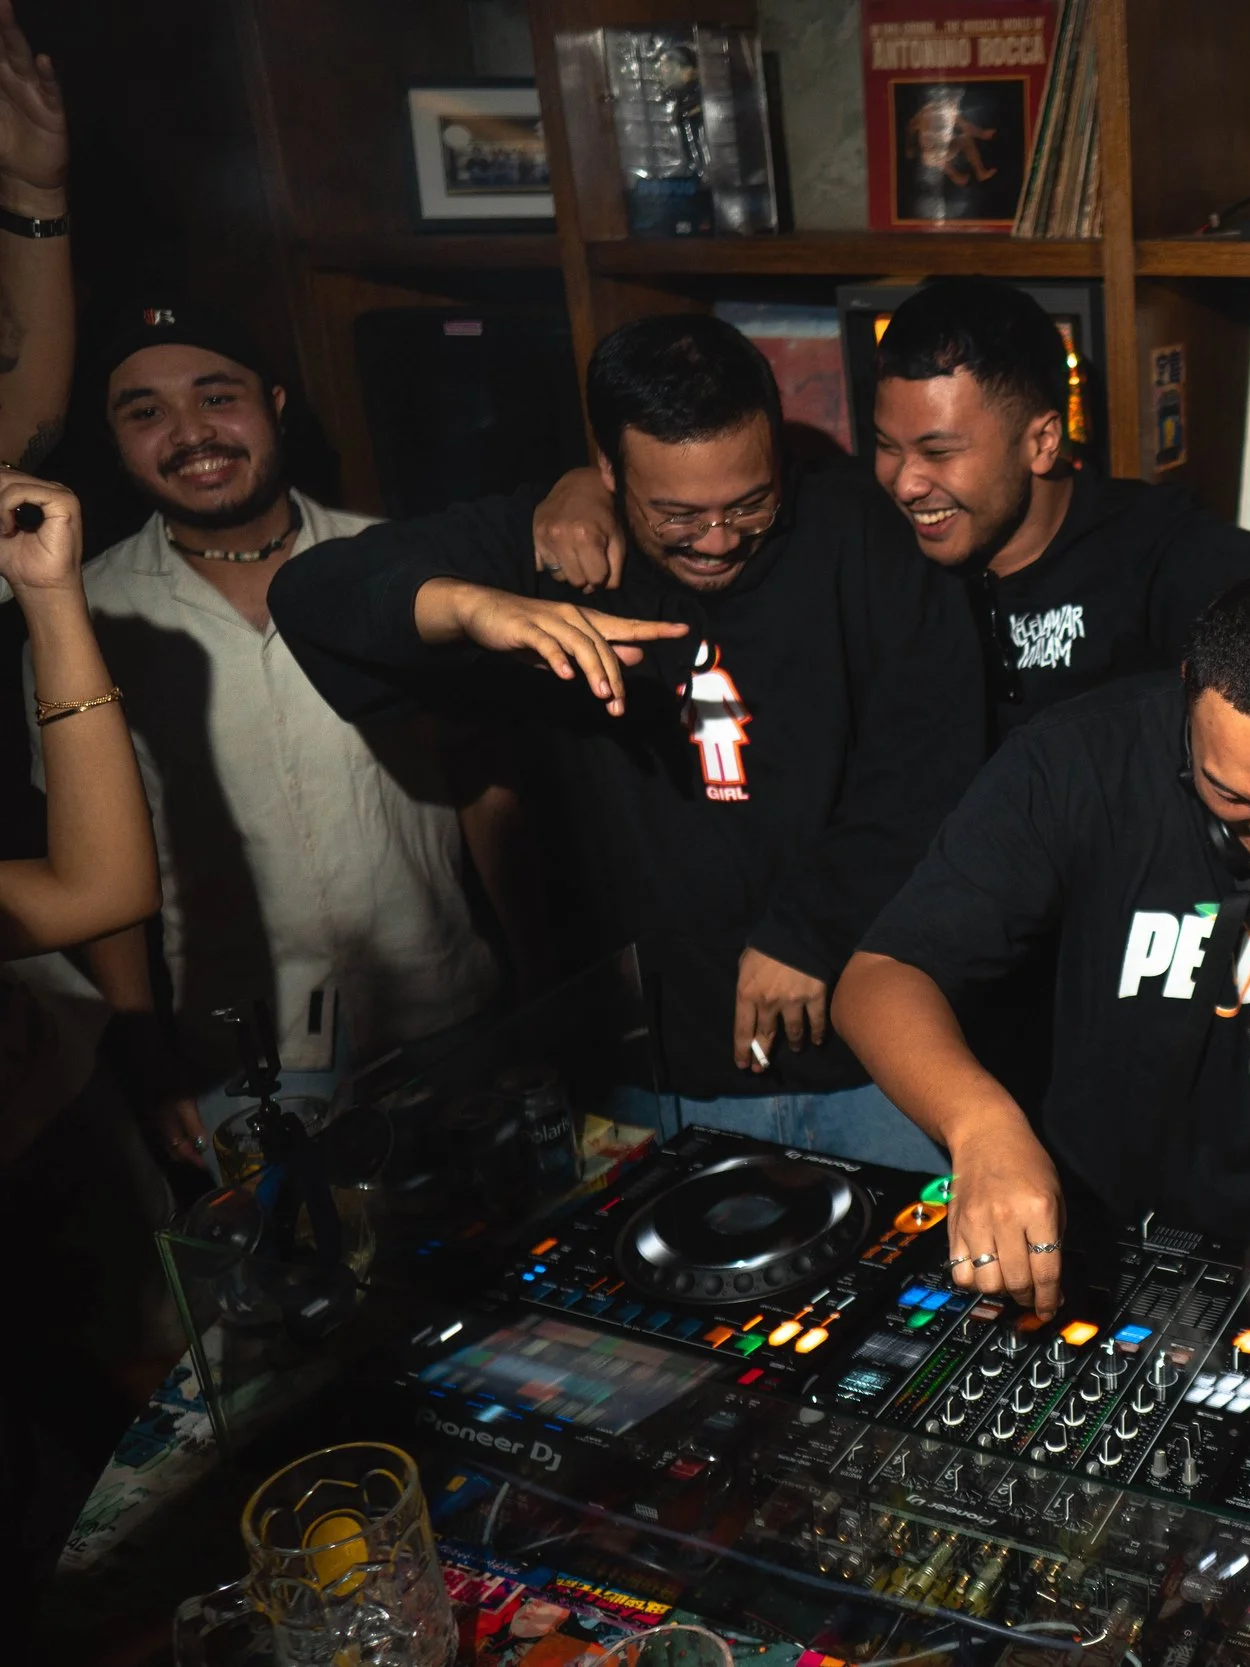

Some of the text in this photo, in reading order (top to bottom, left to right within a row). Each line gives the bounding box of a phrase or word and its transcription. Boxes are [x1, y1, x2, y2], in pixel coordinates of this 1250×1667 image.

[976, 34, 1046, 68] ROCCA
[1016, 637, 1074, 671] MALAM
[706, 786, 750, 801] GIRL
[784, 1149, 862, 1173] Pioneer DJ
[414, 1406, 525, 1455] Pioneer
[529, 1440, 564, 1473] DJ
[892, 1455, 902, 1465] 4
[944, 1469, 955, 1480] 3
[997, 1484, 1009, 1495] 2
[905, 1493, 997, 1526] Pioneer DJ
[1053, 1498, 1062, 1508] 1
